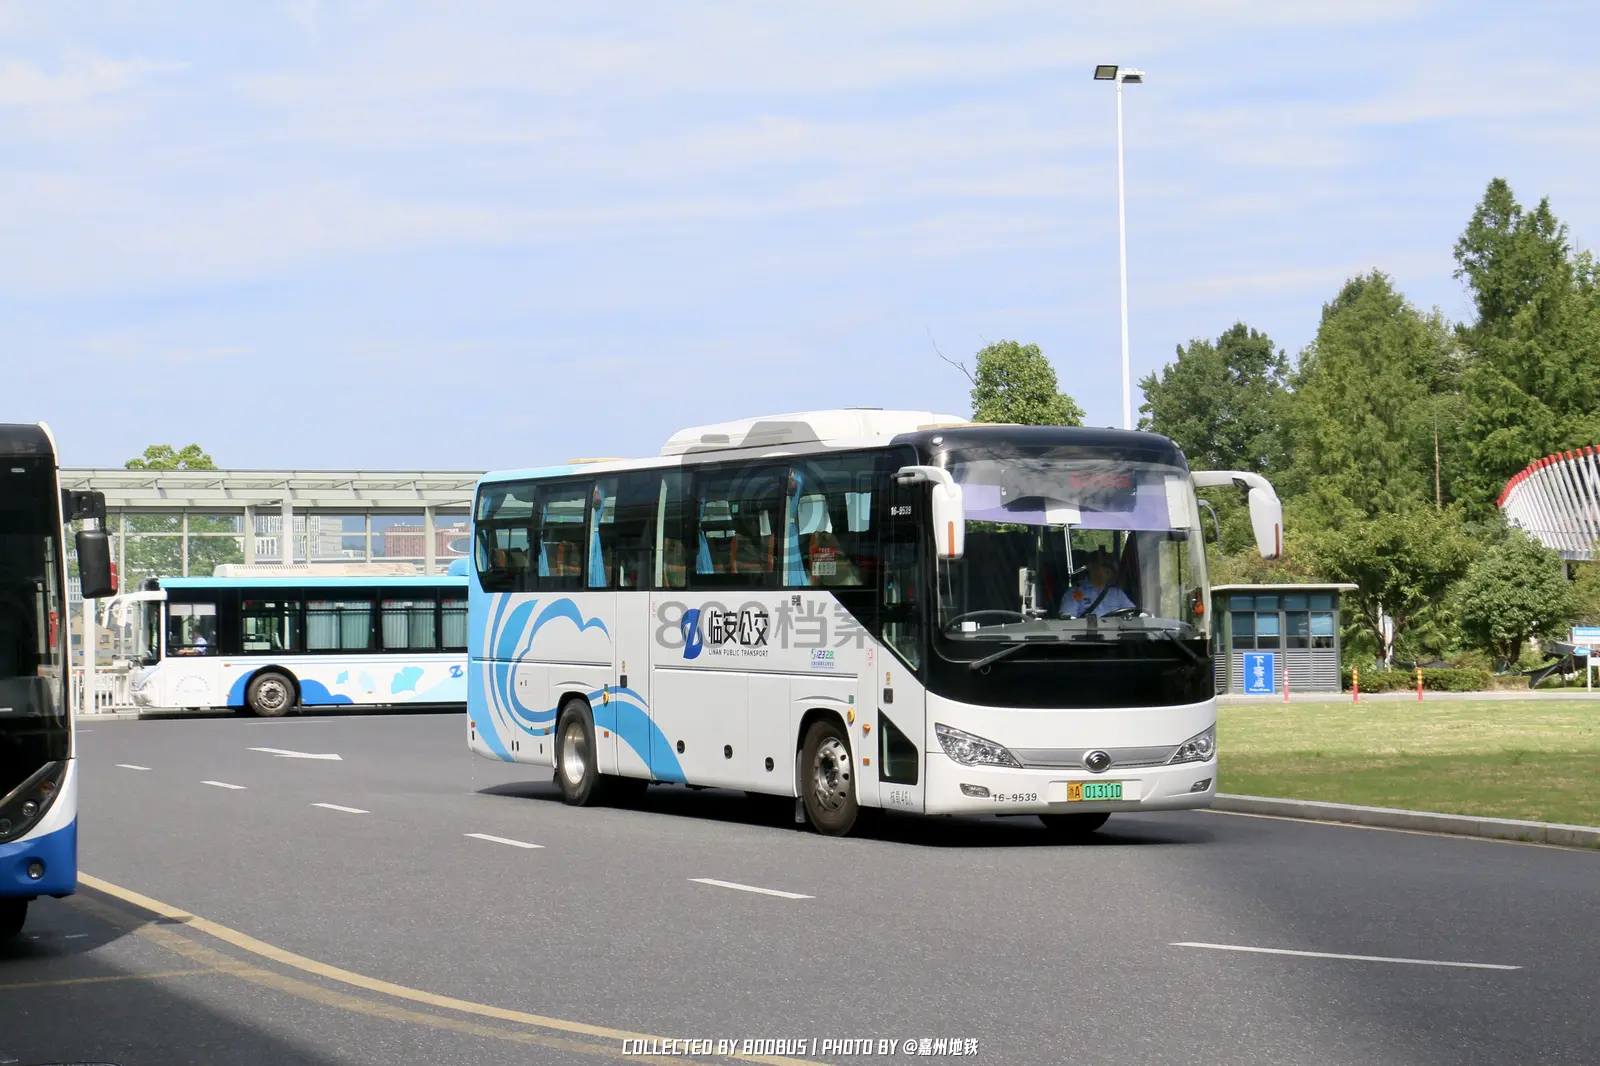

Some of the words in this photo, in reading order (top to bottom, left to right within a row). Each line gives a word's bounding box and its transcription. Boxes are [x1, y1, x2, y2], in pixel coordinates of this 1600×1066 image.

[890, 505, 912, 516] 16-9539
[708, 610, 769, 646] 临安公交
[708, 648, 722, 656] LINAN
[723, 649, 740, 657] PUBLIC
[741, 649, 769, 658] TRANSPORT
[992, 792, 1038, 802] 16-9539
